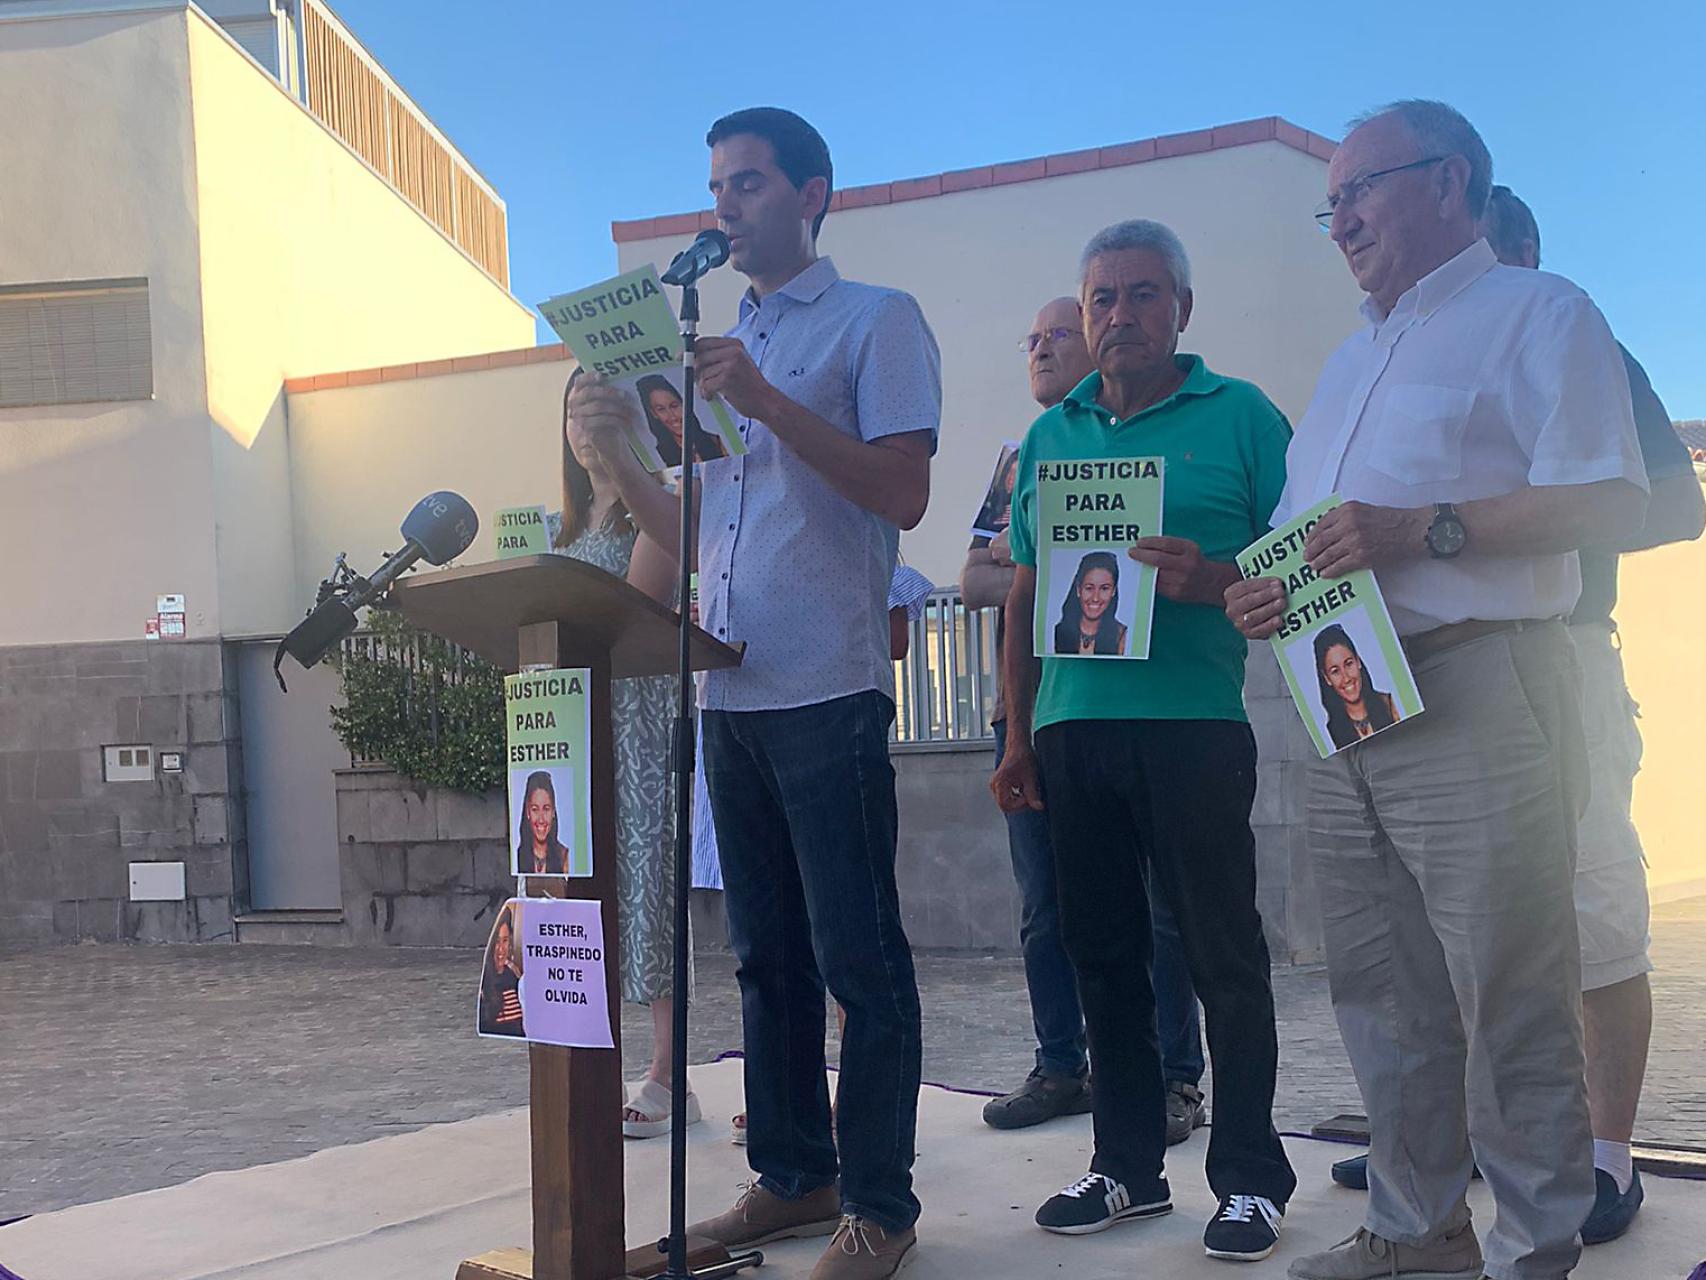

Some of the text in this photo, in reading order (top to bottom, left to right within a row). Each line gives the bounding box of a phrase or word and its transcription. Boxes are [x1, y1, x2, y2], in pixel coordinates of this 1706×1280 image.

[545, 278, 659, 327] #JUSTICIA
[585, 321, 644, 349] PARA
[593, 346, 673, 377] ESTHER
[1038, 461, 1158, 482] #JUSTICIA
[1066, 493, 1126, 511] PARA
[497, 536, 528, 549] PARA
[1052, 524, 1140, 542] ESTHER
[506, 677, 583, 701] JUSTICIA
[516, 711, 556, 731] PARA
[510, 742, 569, 762] ESTHER
[539, 924, 588, 941] ESTHER,
[526, 945, 602, 961] TRASPINEDO
[548, 968, 583, 982] NO TE
[545, 989, 588, 1005] OLVIDA
